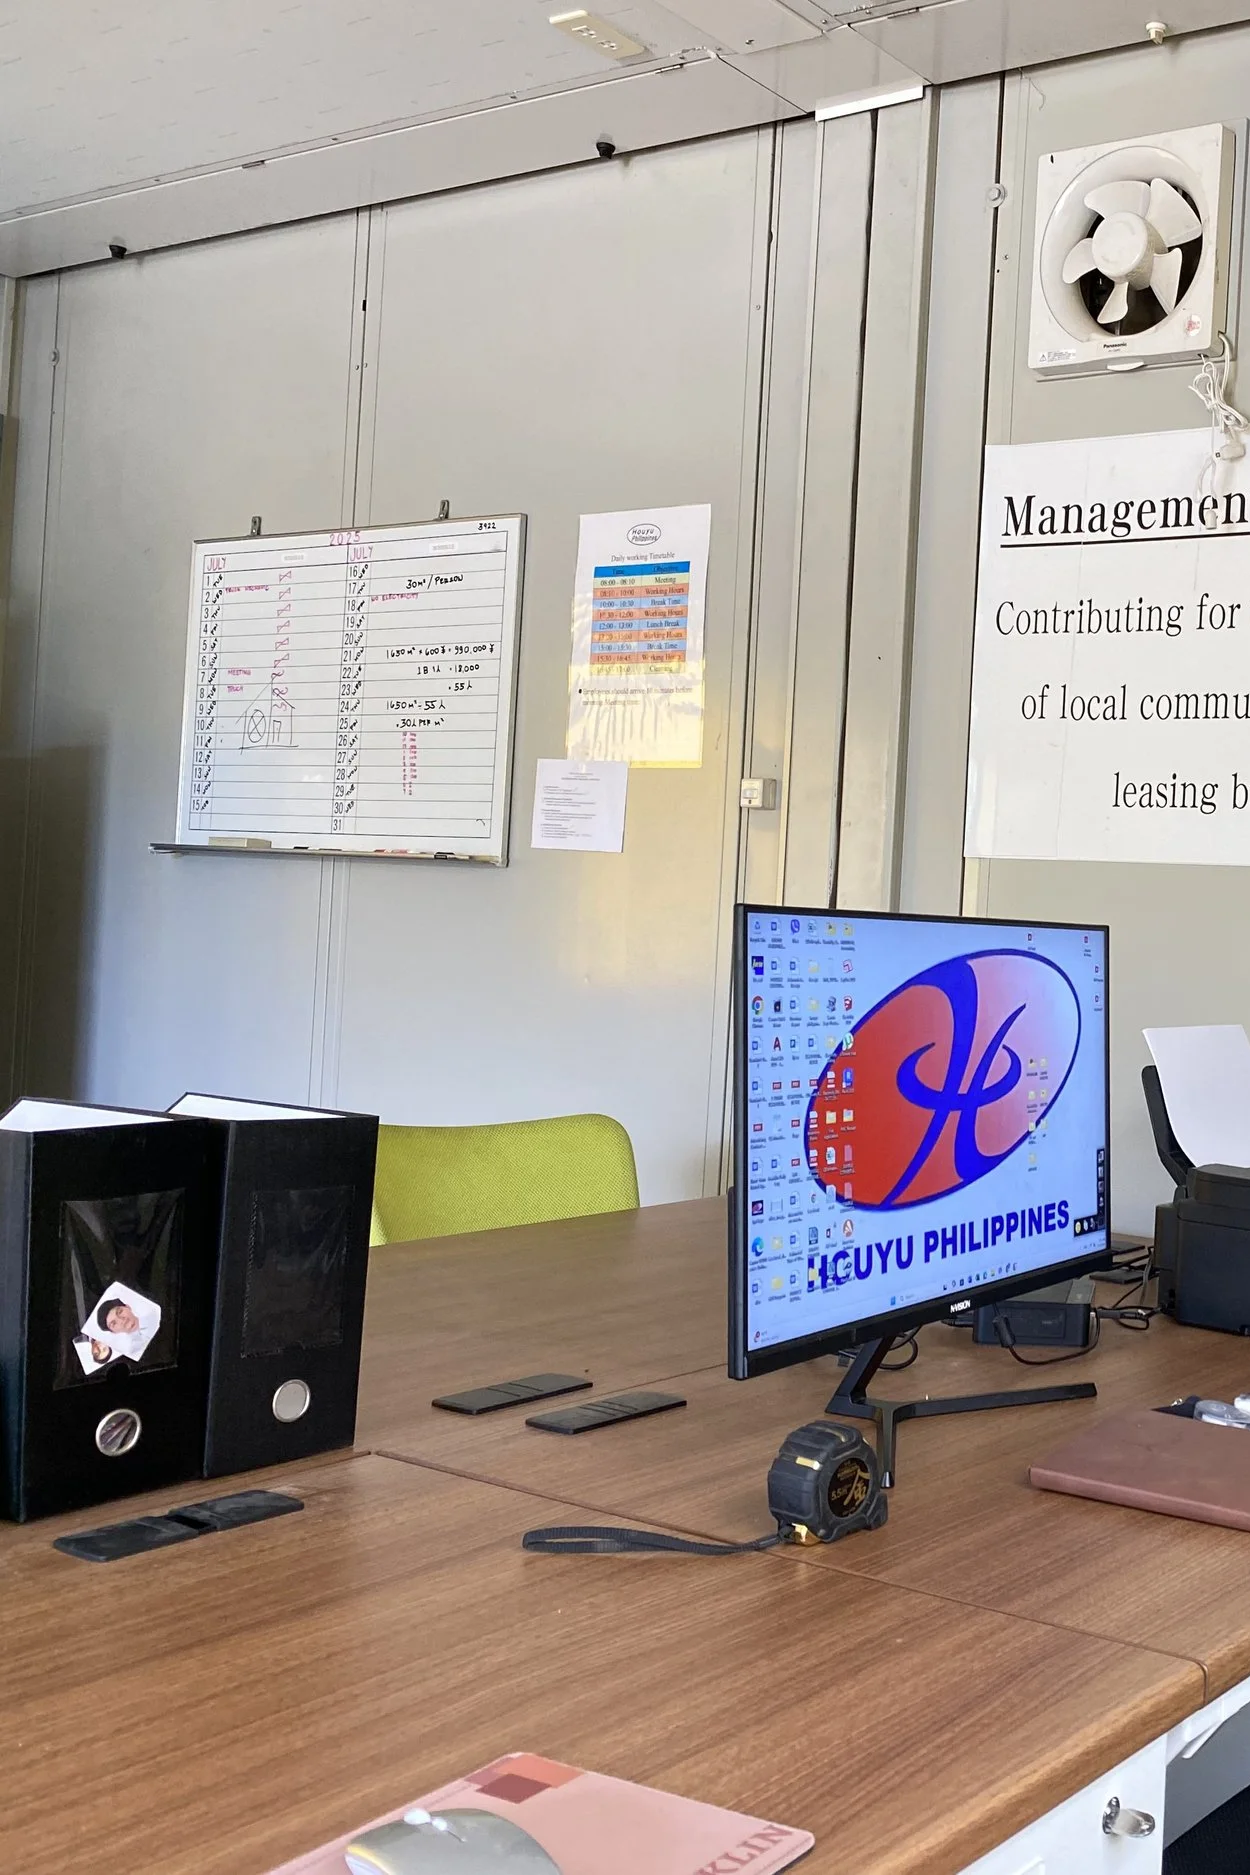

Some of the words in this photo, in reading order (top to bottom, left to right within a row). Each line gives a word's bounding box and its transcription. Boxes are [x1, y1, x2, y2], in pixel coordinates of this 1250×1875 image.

[1103, 342, 1128, 350] Panasonic
[329, 531, 360, 546] 2025
[351, 546, 373, 561] JULY
[650, 552, 674, 560] Timetable
[207, 557, 226, 571] JULY
[349, 565, 358, 578] 16
[348, 582, 356, 594] 17
[646, 588, 667, 596] Working
[205, 591, 210, 602] 2
[348, 600, 356, 612] 18
[204, 608, 209, 619] 3
[644, 610, 666, 618] Working
[995, 596, 1184, 637] Contributing
[1196, 593, 1241, 630] for
[346, 616, 354, 628] 19
[203, 624, 208, 634] 4
[344, 632, 354, 645] 20
[202, 640, 208, 651] 5
[202, 655, 206, 667] 6
[343, 650, 352, 662] 21
[201, 672, 206, 682] 7
[342, 666, 352, 679] 22
[200, 688, 204, 699] 8
[342, 684, 350, 696] 23
[340, 700, 349, 712] 24
[1021, 684, 1051, 720] of
[1060, 684, 1128, 721] local
[199, 704, 204, 714] 9
[198, 720, 204, 730] 10
[340, 718, 348, 730] 25
[197, 736, 203, 746] 11
[338, 734, 348, 746] 26
[196, 752, 202, 762] 12
[337, 752, 346, 764] 27
[194, 768, 202, 778] 13
[336, 768, 346, 780] 28
[194, 784, 200, 794] 14
[335, 785, 344, 798] 29
[1112, 772, 1219, 815] leasing
[192, 800, 200, 811] 15
[334, 802, 344, 814] 30
[333, 818, 342, 831] 31
[807, 1235, 914, 1293] HOUYU
[924, 1200, 1070, 1263] PHILIPPINES
